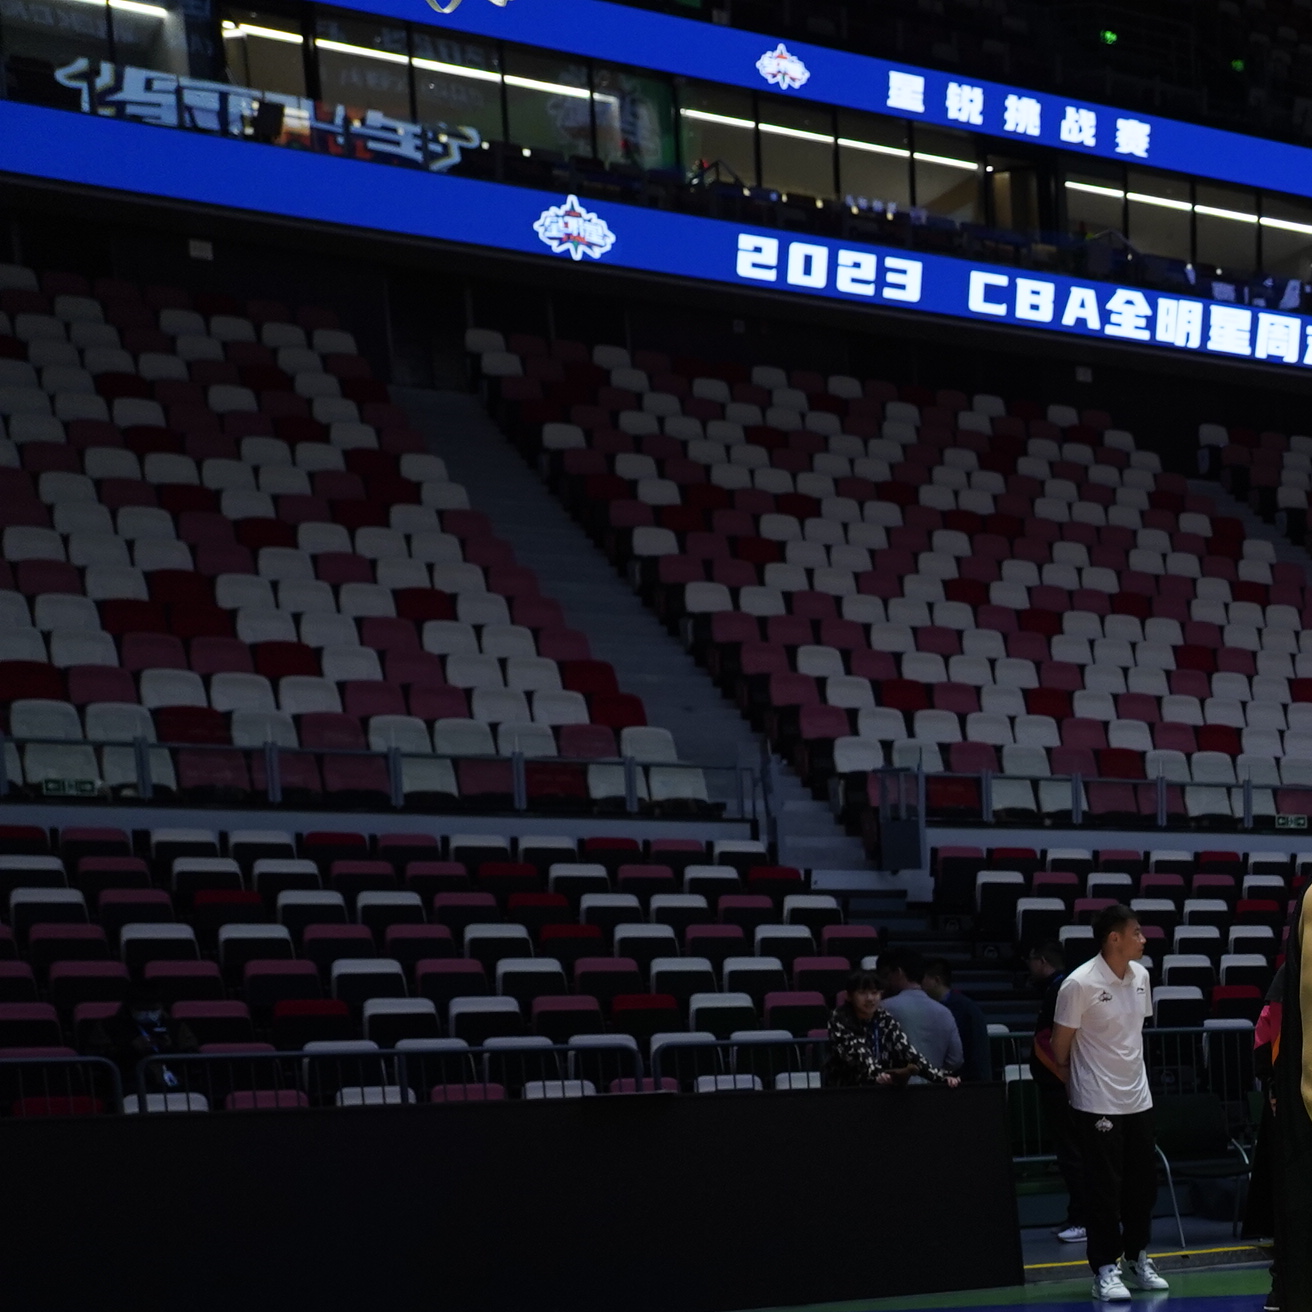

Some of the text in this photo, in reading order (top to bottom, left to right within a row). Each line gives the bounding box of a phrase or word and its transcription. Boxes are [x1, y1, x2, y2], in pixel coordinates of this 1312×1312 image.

[886, 70, 1151, 158] 星锐挑战赛
[736, 233, 923, 303] 2023
